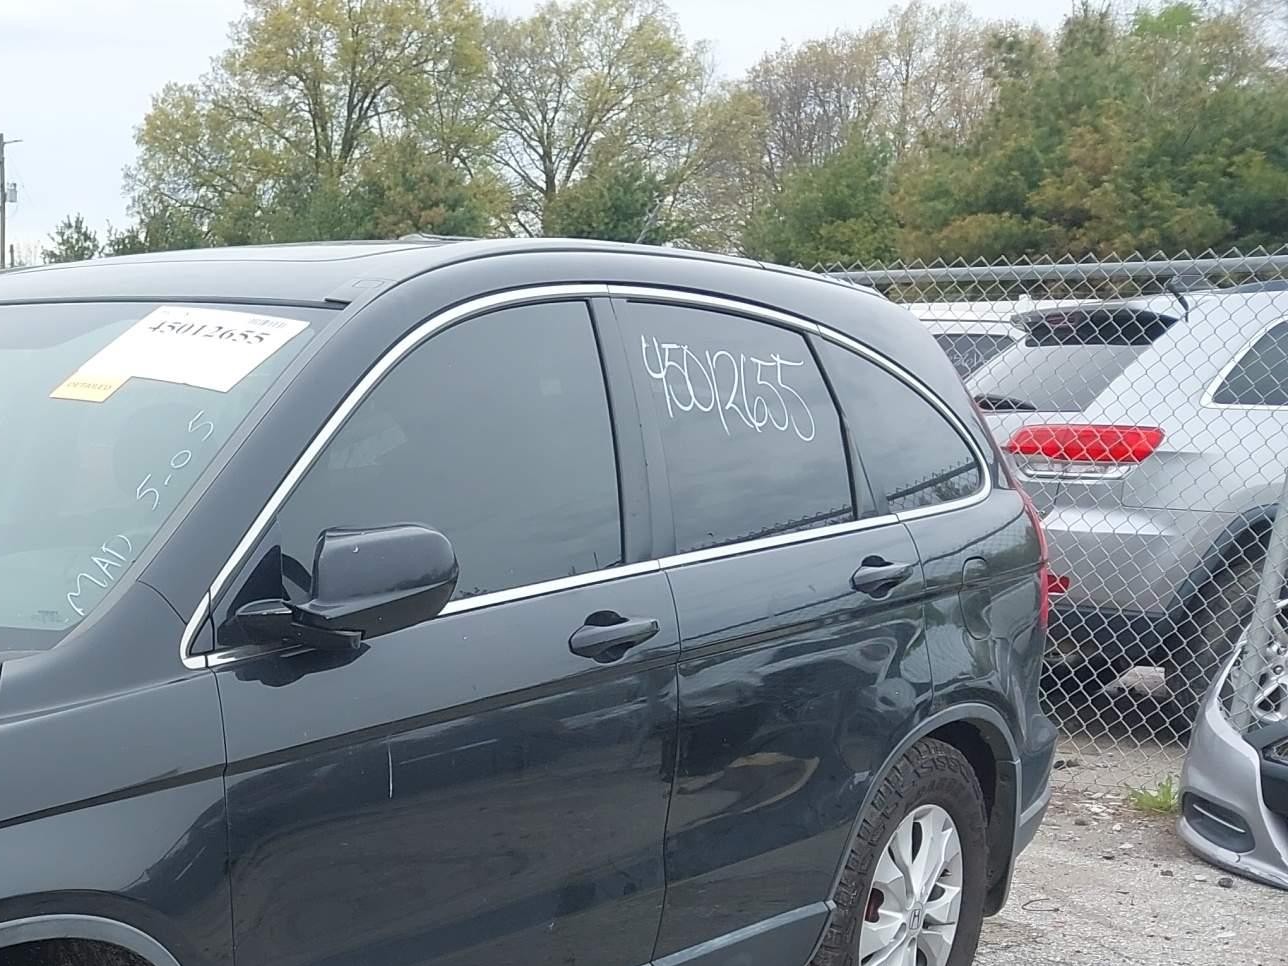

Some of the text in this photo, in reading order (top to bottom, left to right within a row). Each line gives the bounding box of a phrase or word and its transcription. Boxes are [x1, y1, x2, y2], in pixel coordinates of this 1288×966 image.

[147, 320, 271, 345] 45012655
[640, 334, 816, 442] 45012655
[66, 533, 133, 616] MAD
